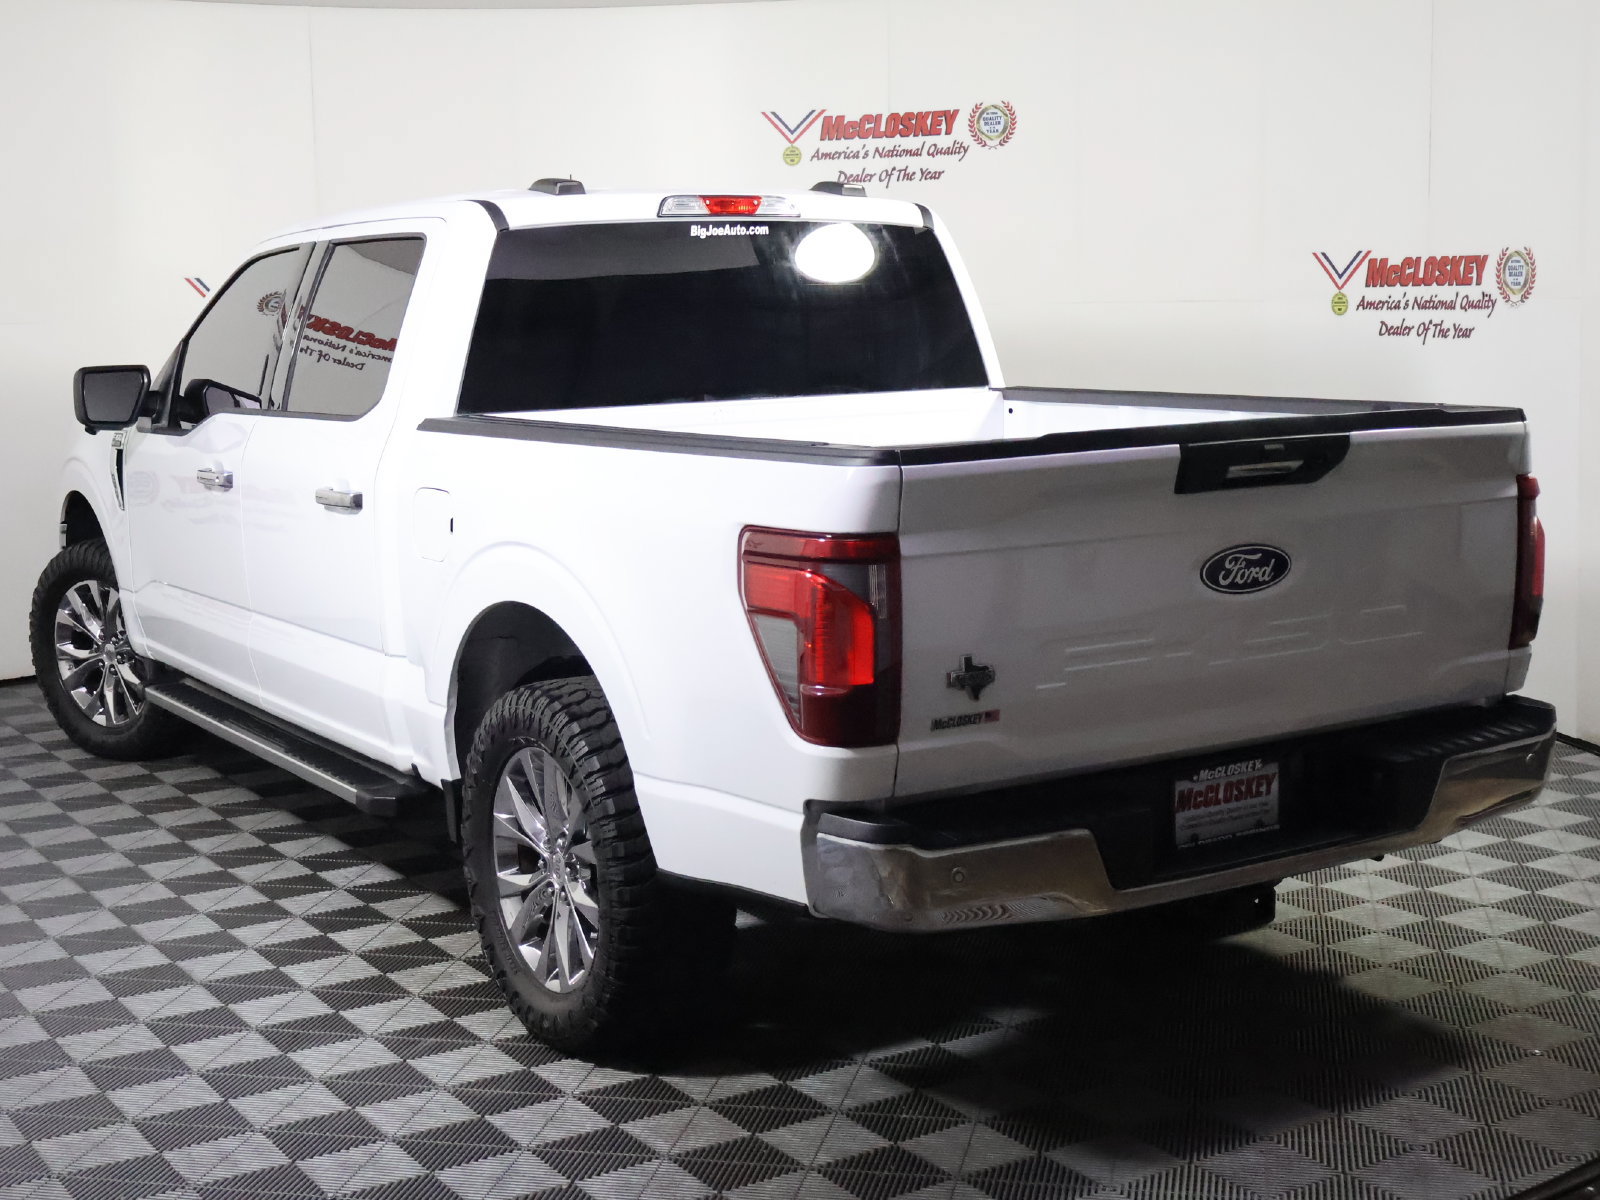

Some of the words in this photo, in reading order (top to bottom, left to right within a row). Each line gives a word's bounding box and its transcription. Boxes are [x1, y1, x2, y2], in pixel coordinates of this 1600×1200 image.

[820, 109, 960, 141] McCLOSKEY
[810, 143, 869, 162] America's
[873, 141, 922, 159] National
[927, 140, 970, 162] Quality
[837, 165, 876, 183] Dealer
[878, 167, 896, 188] Of
[897, 167, 917, 182] The
[919, 168, 945, 182] Year
[690, 224, 769, 239] BigJoeAuto.com
[1365, 254, 1489, 288] McCLOSKEY
[1356, 292, 1409, 311] America's
[1412, 292, 1457, 311] National
[1460, 291, 1497, 318] Quality
[1378, 318, 1414, 337] Dealer
[1416, 319, 1433, 345] Of
[1433, 322, 1450, 339] The
[1453, 323, 1474, 339] Year
[1218, 553, 1275, 586] Ford
[1199, 759, 1262, 781] McCLOSKEY
[1175, 772, 1279, 813] McCLOSKEY
